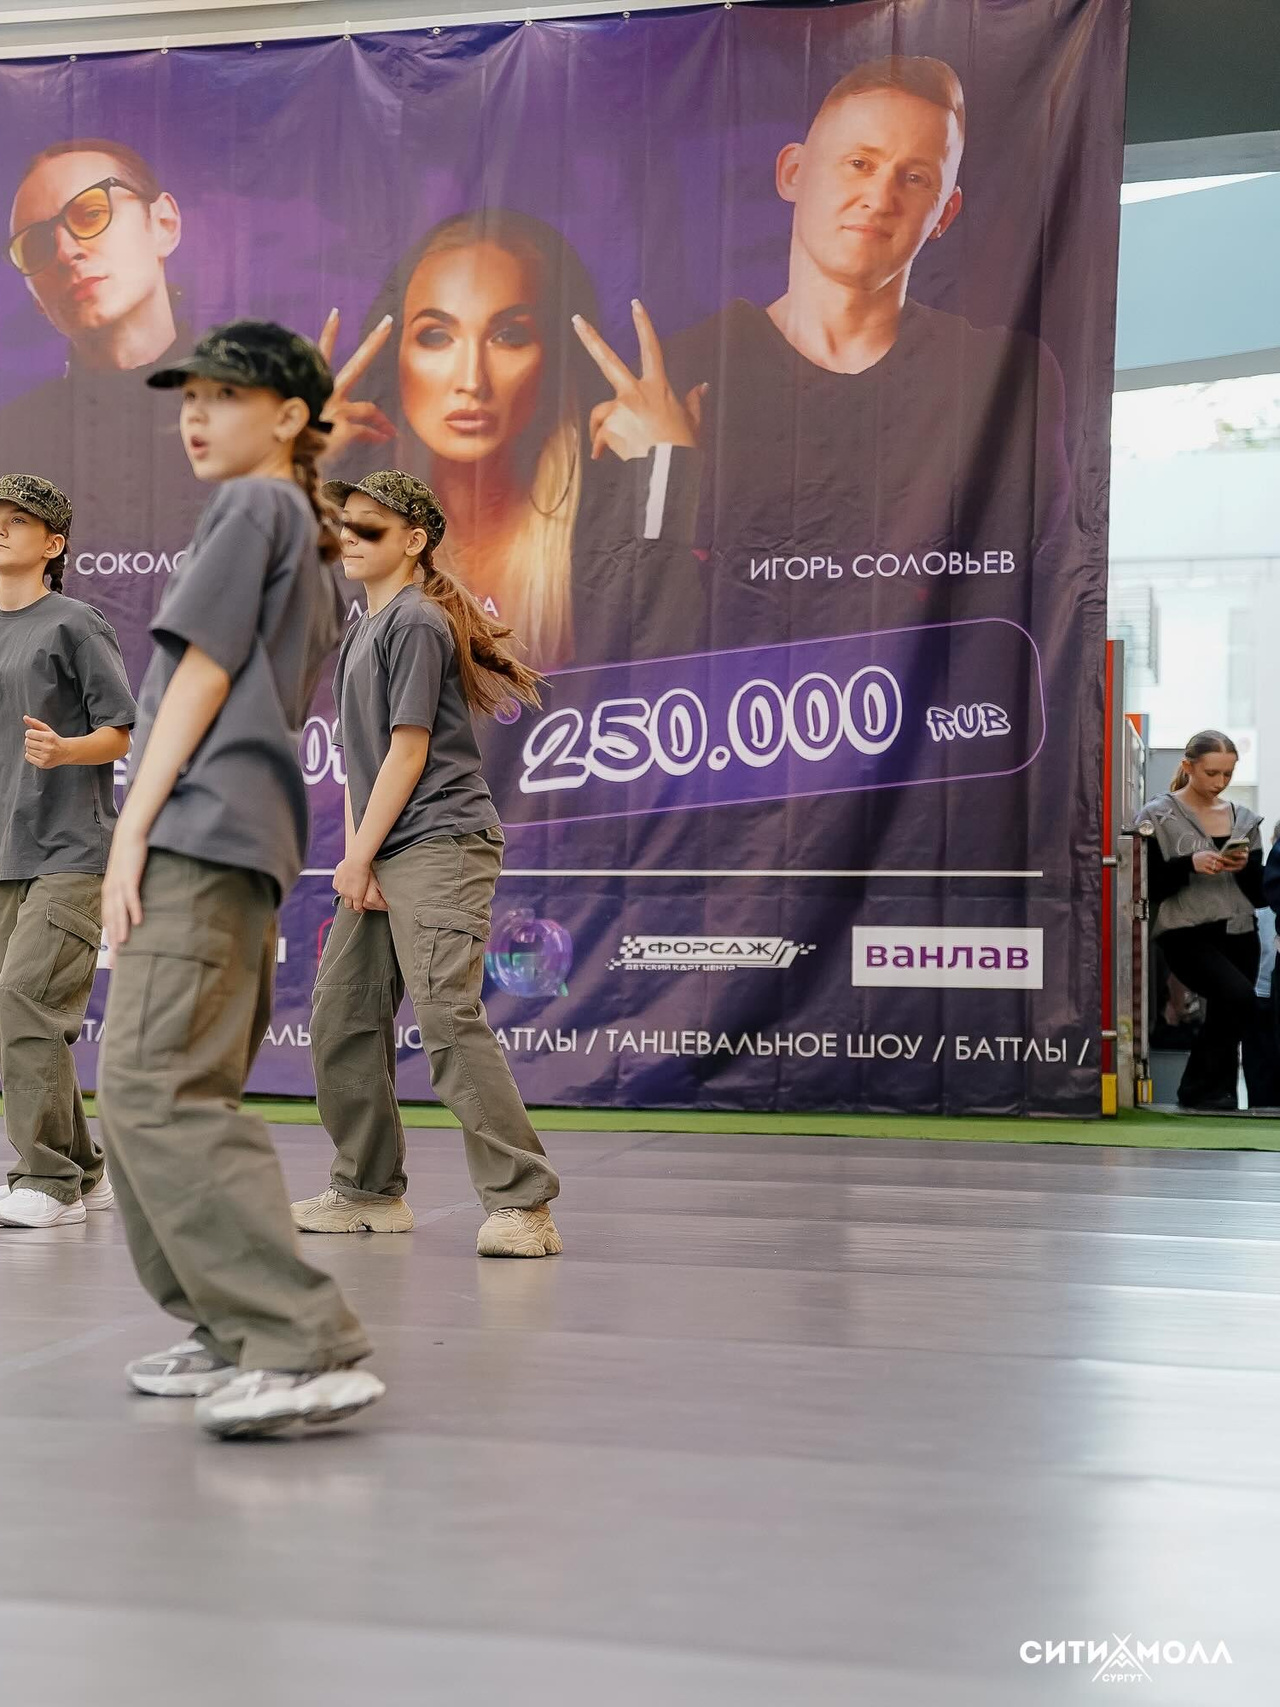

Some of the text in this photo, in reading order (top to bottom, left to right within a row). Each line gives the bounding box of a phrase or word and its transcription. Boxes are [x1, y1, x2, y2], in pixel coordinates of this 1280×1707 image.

[750, 551, 1016, 580] ИГОРЬ СОЛОВЬЕВ
[519, 665, 1011, 794] 250.000 RUB
[648, 942, 774, 956] ФОРСАЖ
[866, 945, 1029, 970] ванлав
[496, 1026, 577, 1052] АТТЛЫ
[606, 1029, 837, 1057] ТАНЦЕВАЛЬНОЕ
[847, 1033, 923, 1059] ШОУ
[956, 1036, 1067, 1062] БАТТЛЫ
